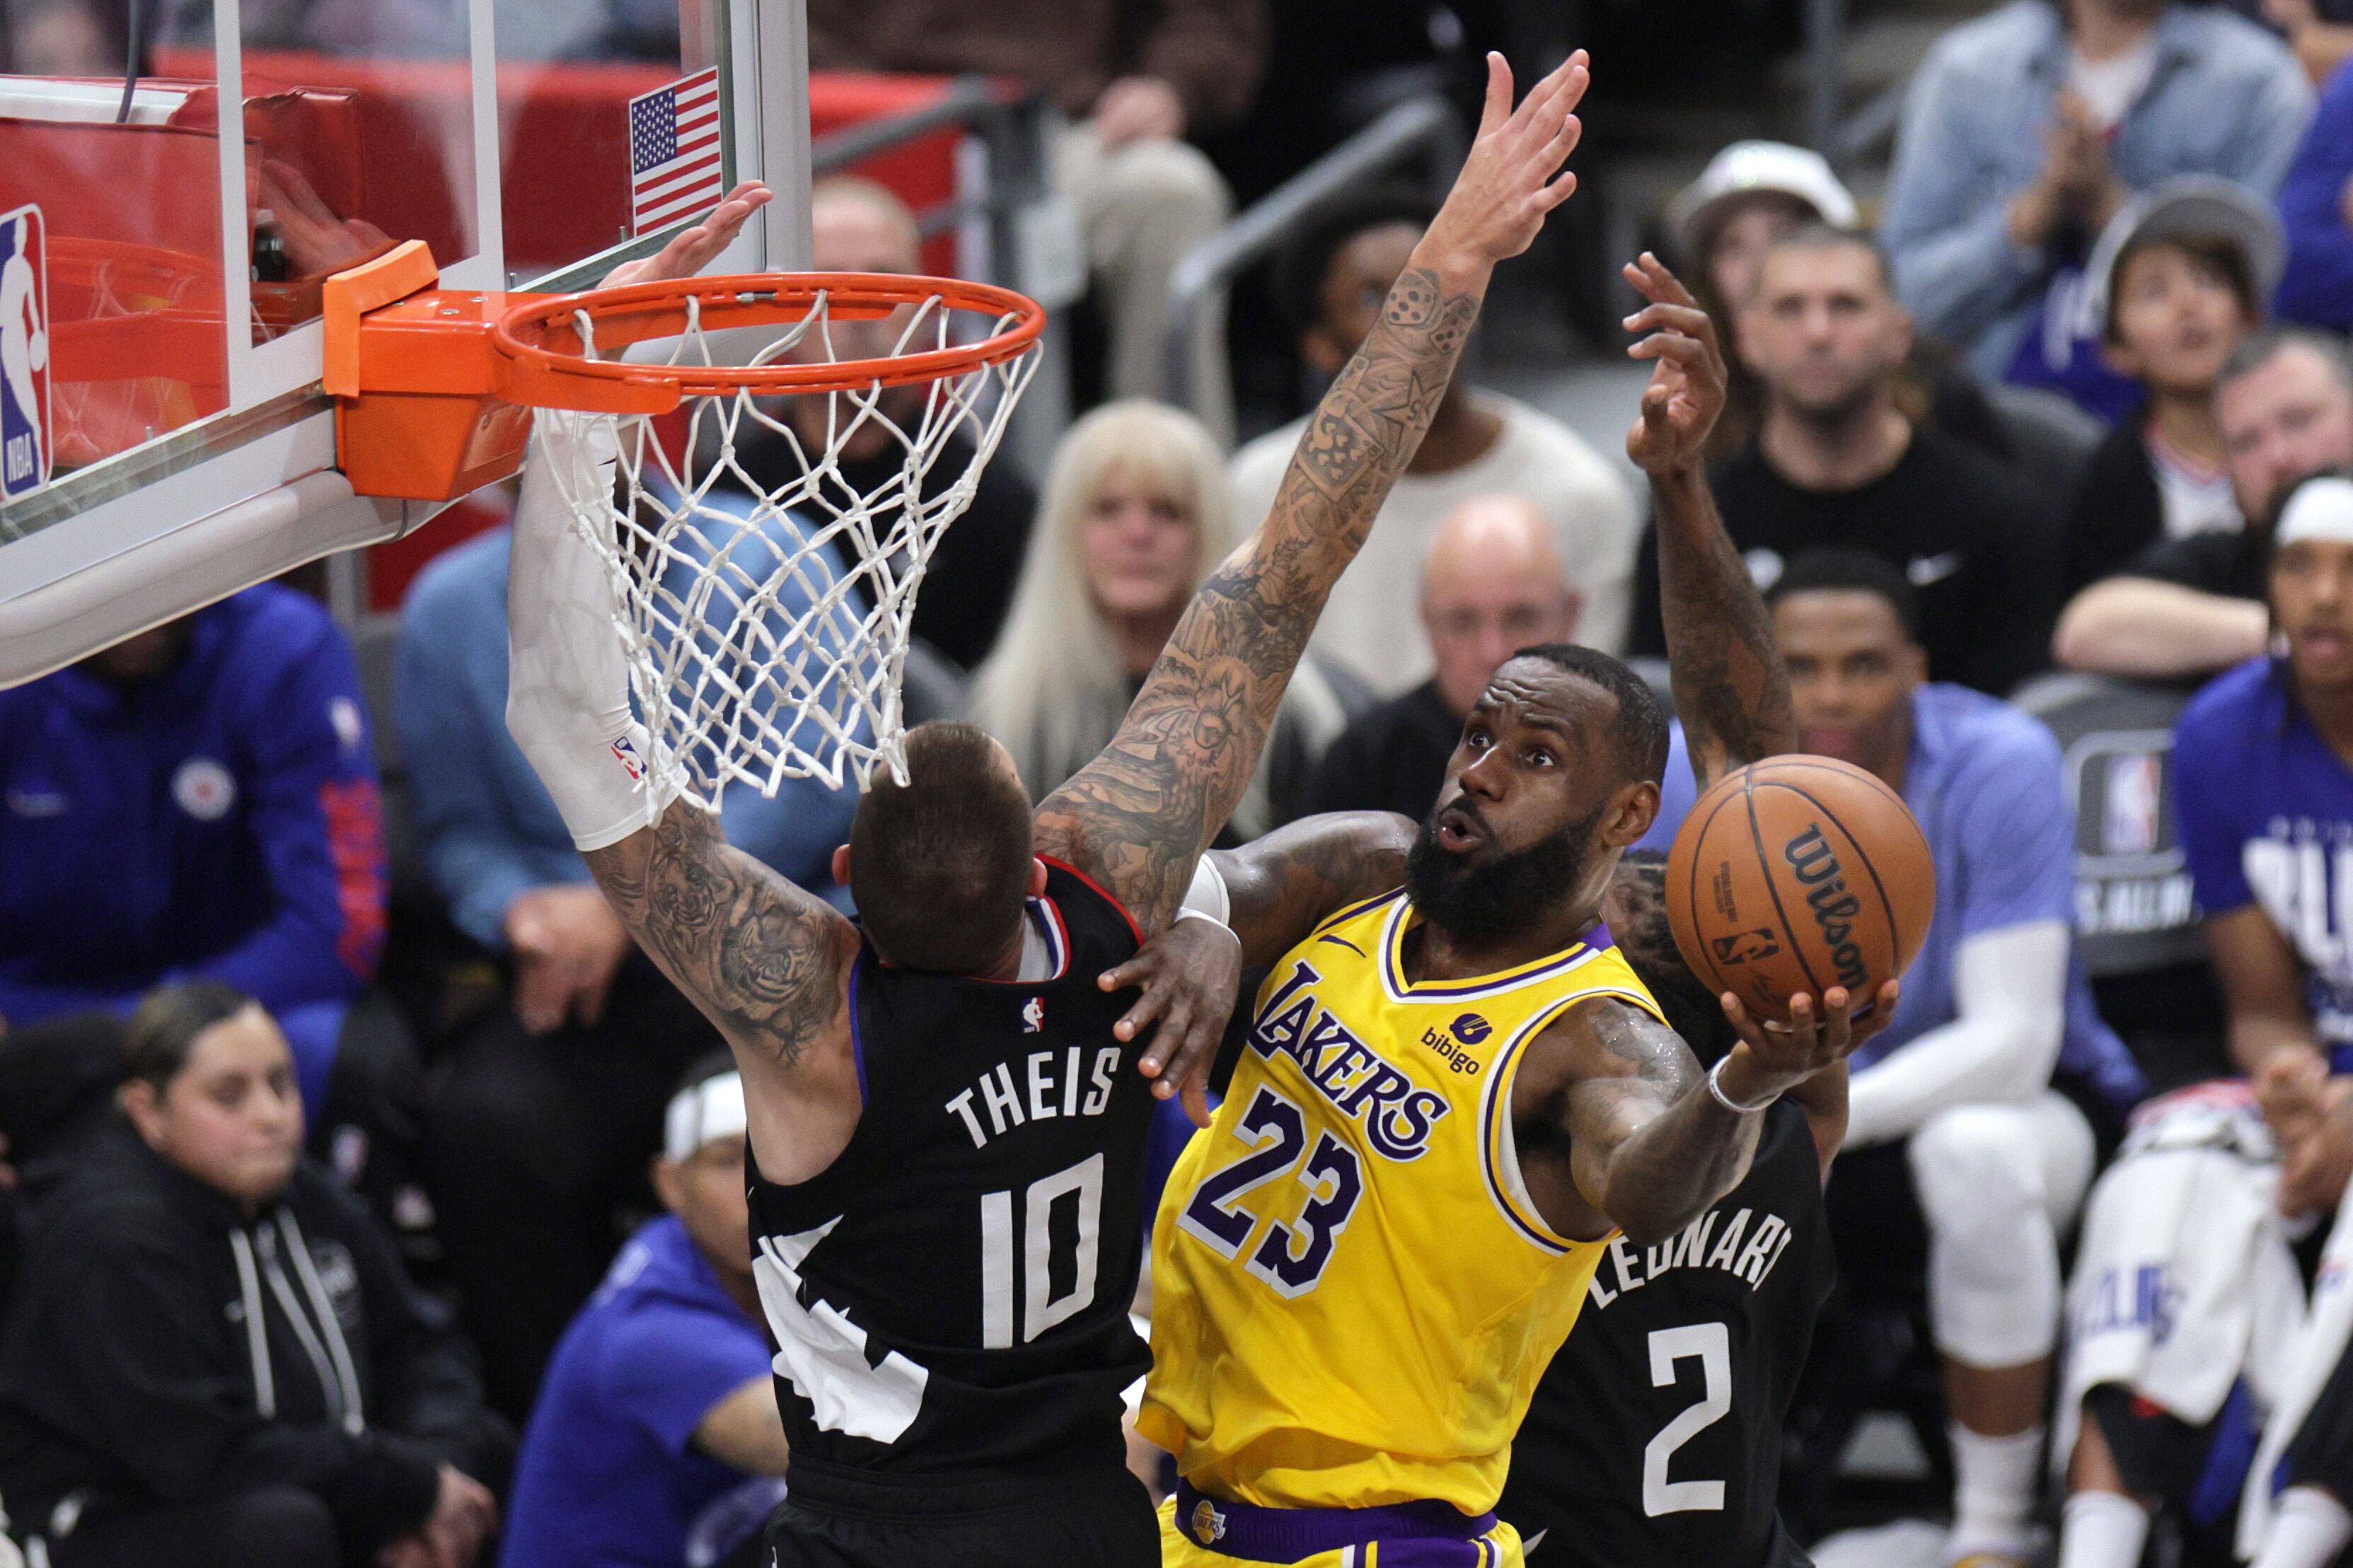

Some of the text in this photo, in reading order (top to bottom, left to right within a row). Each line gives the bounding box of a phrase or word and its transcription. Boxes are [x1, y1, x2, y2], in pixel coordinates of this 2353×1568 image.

[7, 432, 33, 483] NBA
[1784, 821, 1871, 990] Wilson
[945, 1047, 1121, 1149] THEIS
[1247, 957, 1452, 1163] LAKERS
[1421, 1027, 1480, 1075] bibigo
[981, 1152, 1104, 1349] 10
[1176, 1082, 1365, 1300] 23
[1643, 1322, 1732, 1517] 2
